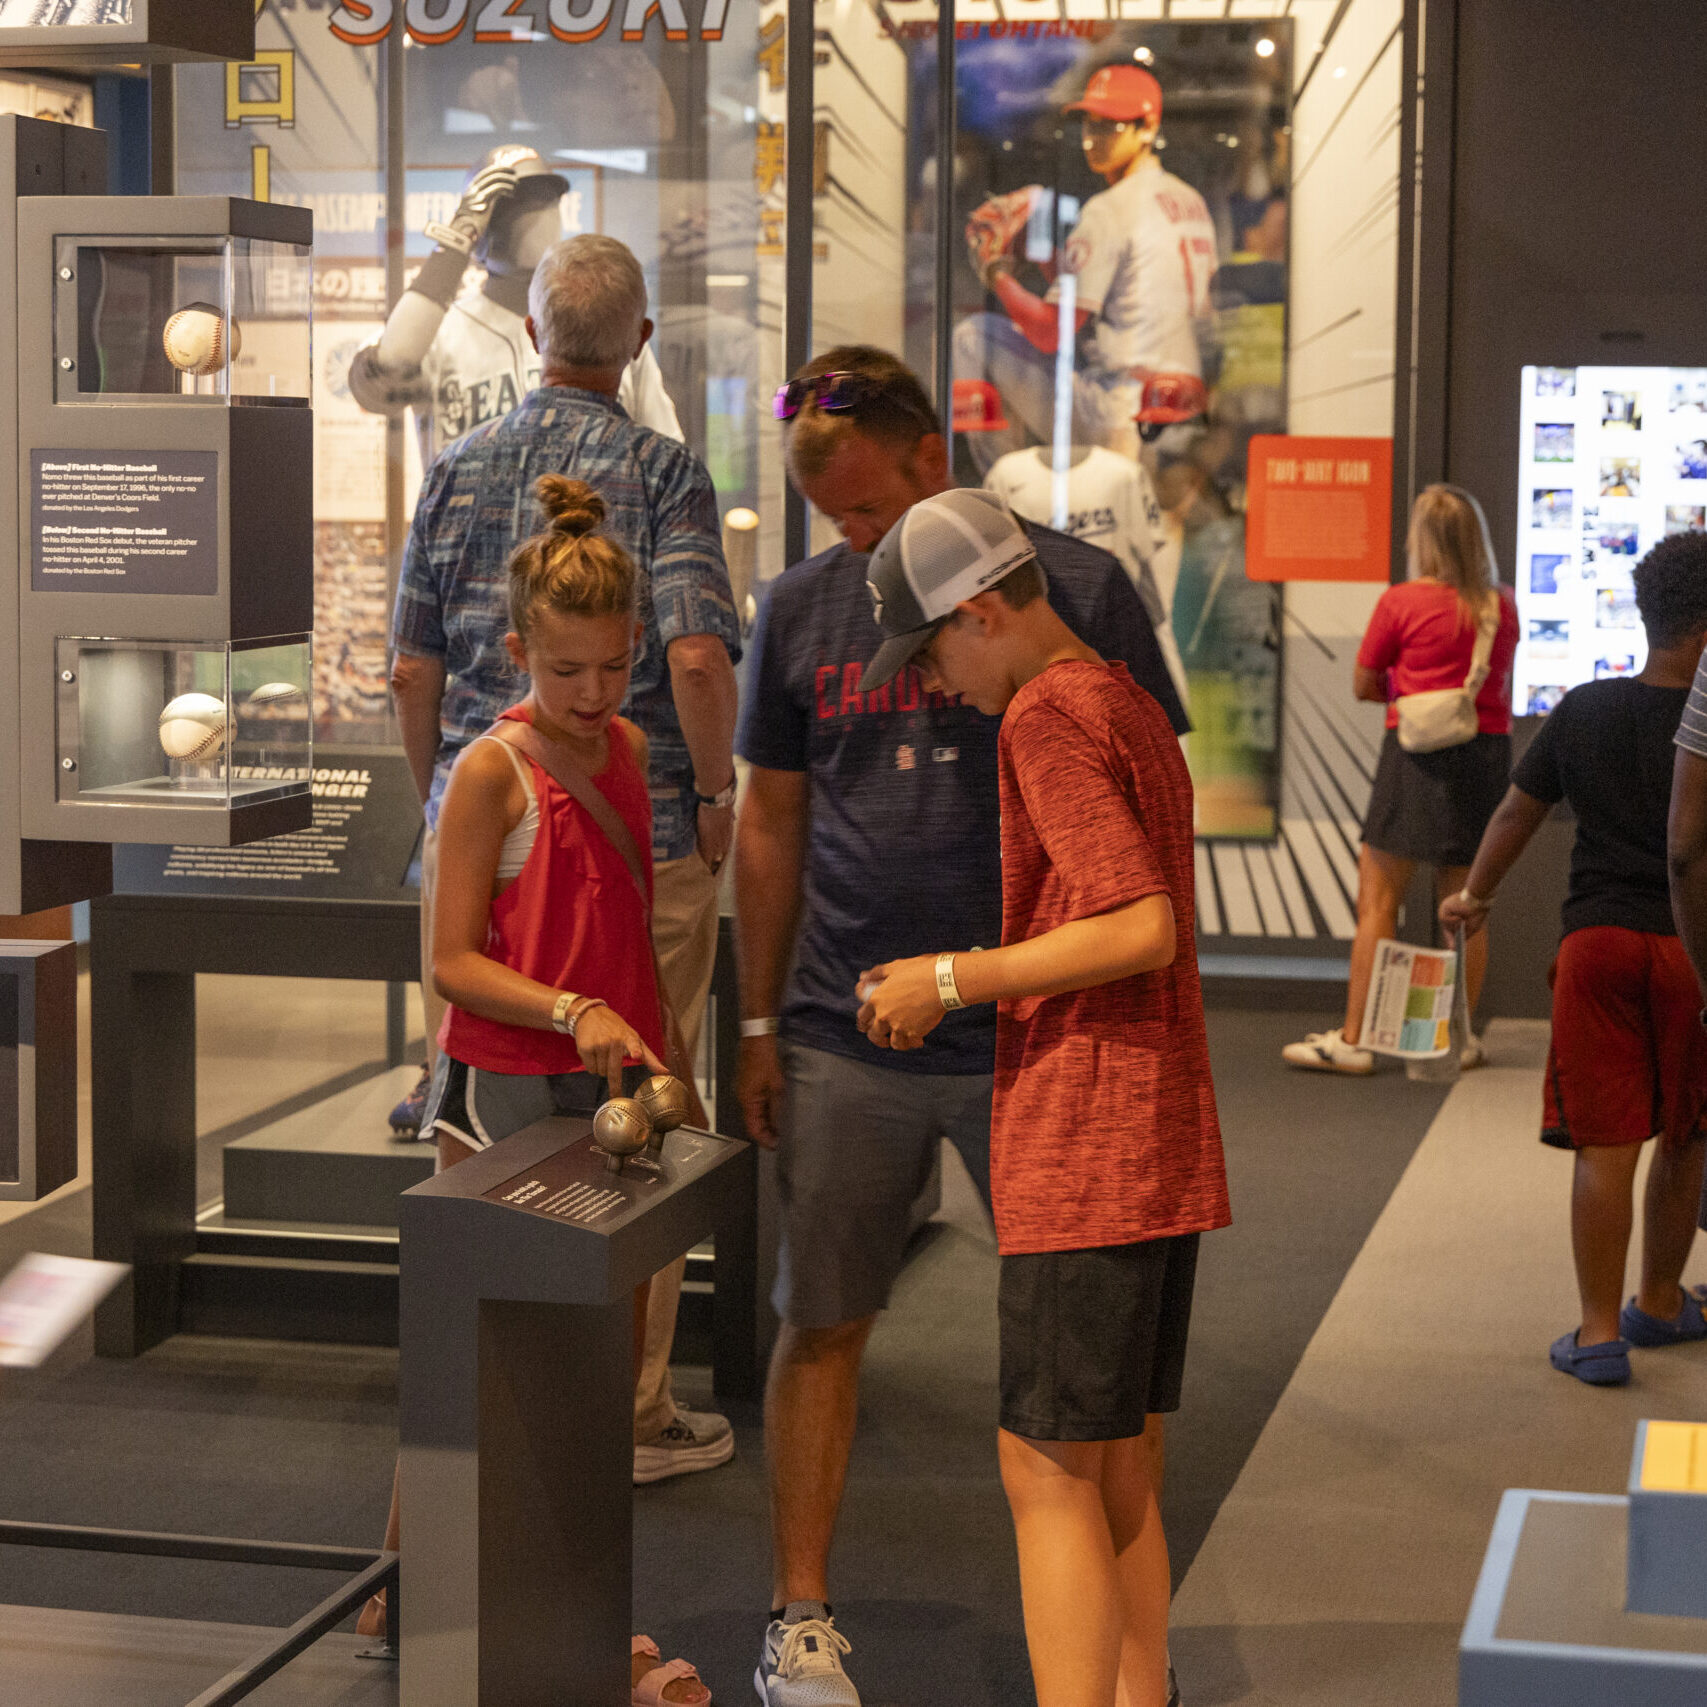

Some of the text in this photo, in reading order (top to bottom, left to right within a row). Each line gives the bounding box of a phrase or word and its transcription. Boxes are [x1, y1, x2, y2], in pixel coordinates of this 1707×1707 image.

[134, 475, 148, 483] part
[81, 483, 119, 492] September
[161, 485, 176, 494] only
[57, 493, 83, 501] pitched
[60, 536, 85, 544] Boston
[174, 539, 198, 547] pitcher
[107, 547, 130, 556] during
[82, 556, 99, 564] April
[312, 782, 369, 798] NGER
